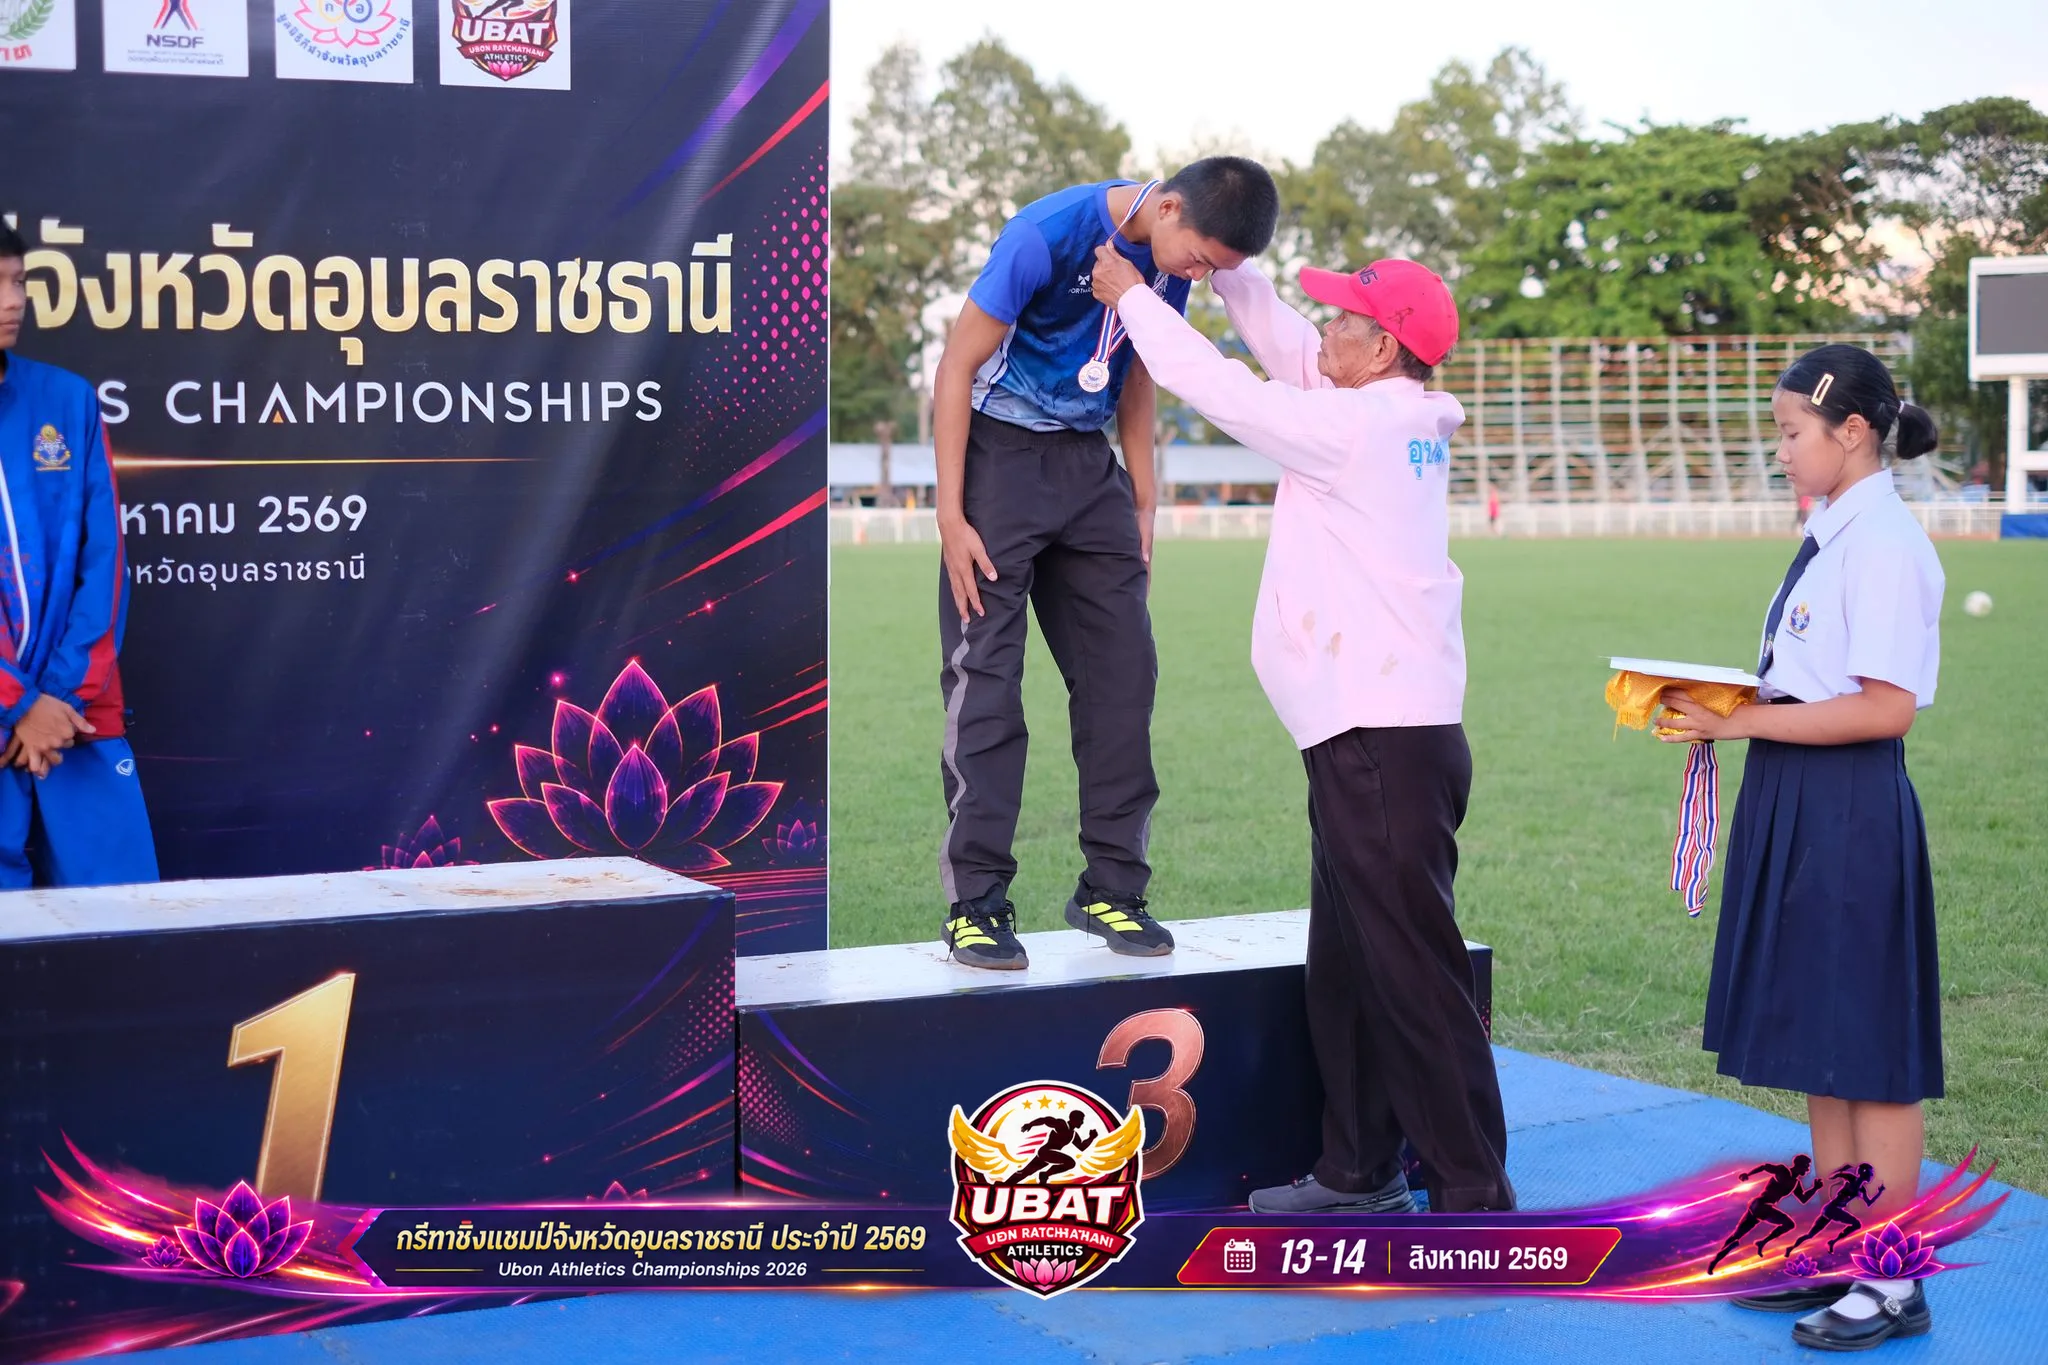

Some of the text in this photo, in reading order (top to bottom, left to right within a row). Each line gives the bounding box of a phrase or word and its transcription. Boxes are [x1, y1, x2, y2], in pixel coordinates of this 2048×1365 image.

[146, 34, 204, 48] NSDF
[461, 18, 550, 45] UBAT
[469, 45, 544, 57] UBON RATCHATHANI
[484, 53, 528, 62] ATHLETICS
[3, 214, 733, 365] จังหวัดอุบลราชธานี
[165, 381, 662, 424] CHAMPIONSHIPS
[258, 495, 367, 533] 2569
[127, 553, 365, 591] หวัดอุบลราชธานี
[228, 973, 356, 1203] 1
[1096, 1007, 1205, 1181] 3
